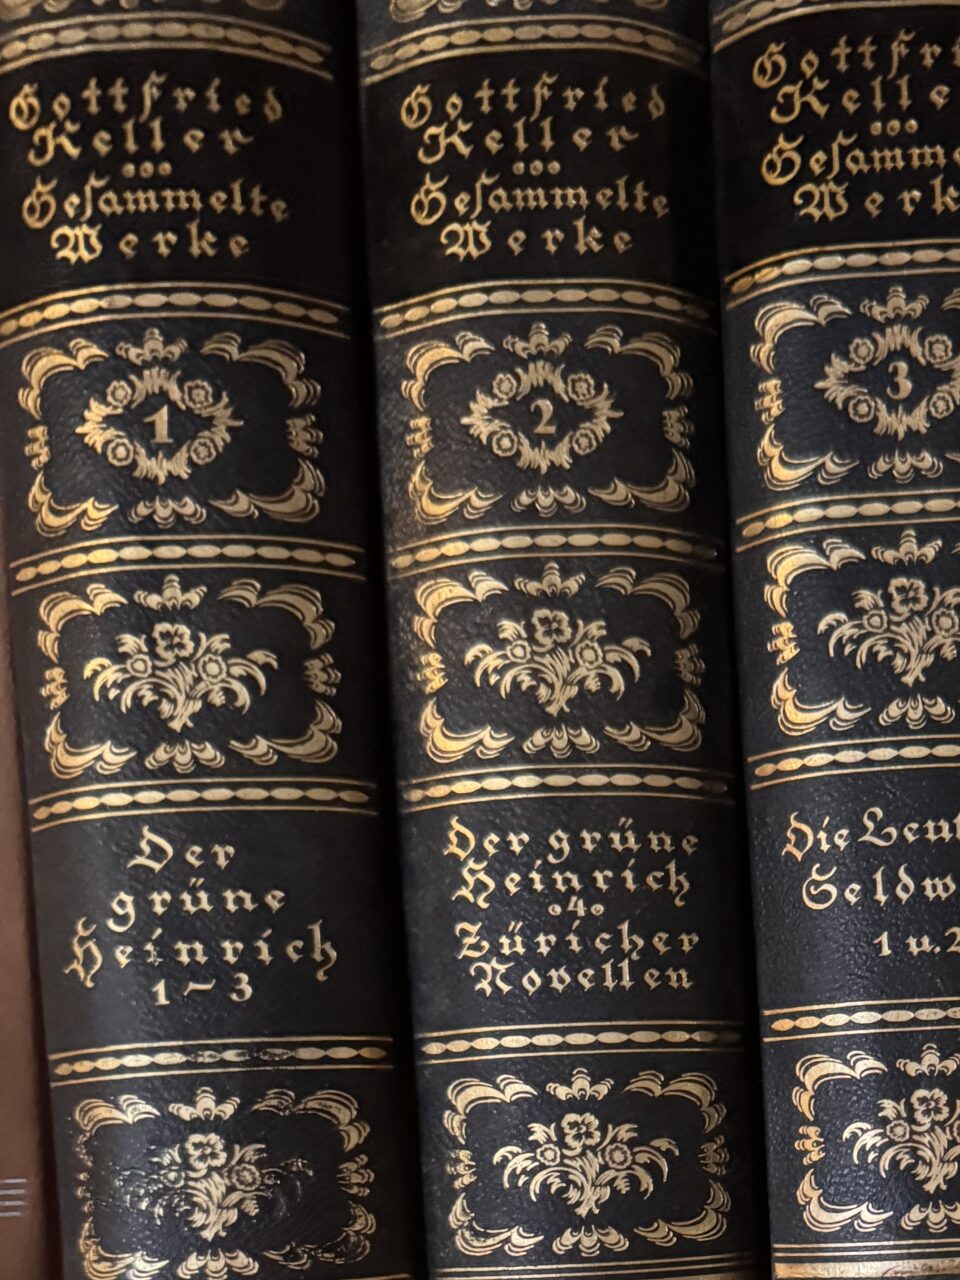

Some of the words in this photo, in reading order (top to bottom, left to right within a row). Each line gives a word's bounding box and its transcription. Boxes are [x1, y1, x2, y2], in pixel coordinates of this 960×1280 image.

[9, 70, 282, 130] Gottfried
[400, 71, 665, 129] Gottfried
[27, 116, 253, 166] Keller
[417, 116, 639, 164] Keller
[51, 218, 249, 264] Werke
[440, 215, 633, 262] Werke
[886, 362, 914, 399] 3
[144, 406, 174, 443] 1
[532, 401, 557, 436] 2
[127, 825, 235, 873] Der
[443, 815, 530, 861] Der
[547, 817, 700, 864] grüne
[781, 811, 850, 862] Die
[106, 877, 286, 933] grüne
[452, 856, 691, 910] Heinrich
[63, 916, 338, 988] Heinrich
[454, 919, 700, 960] Züricher
[469, 956, 693, 999] Novellen
